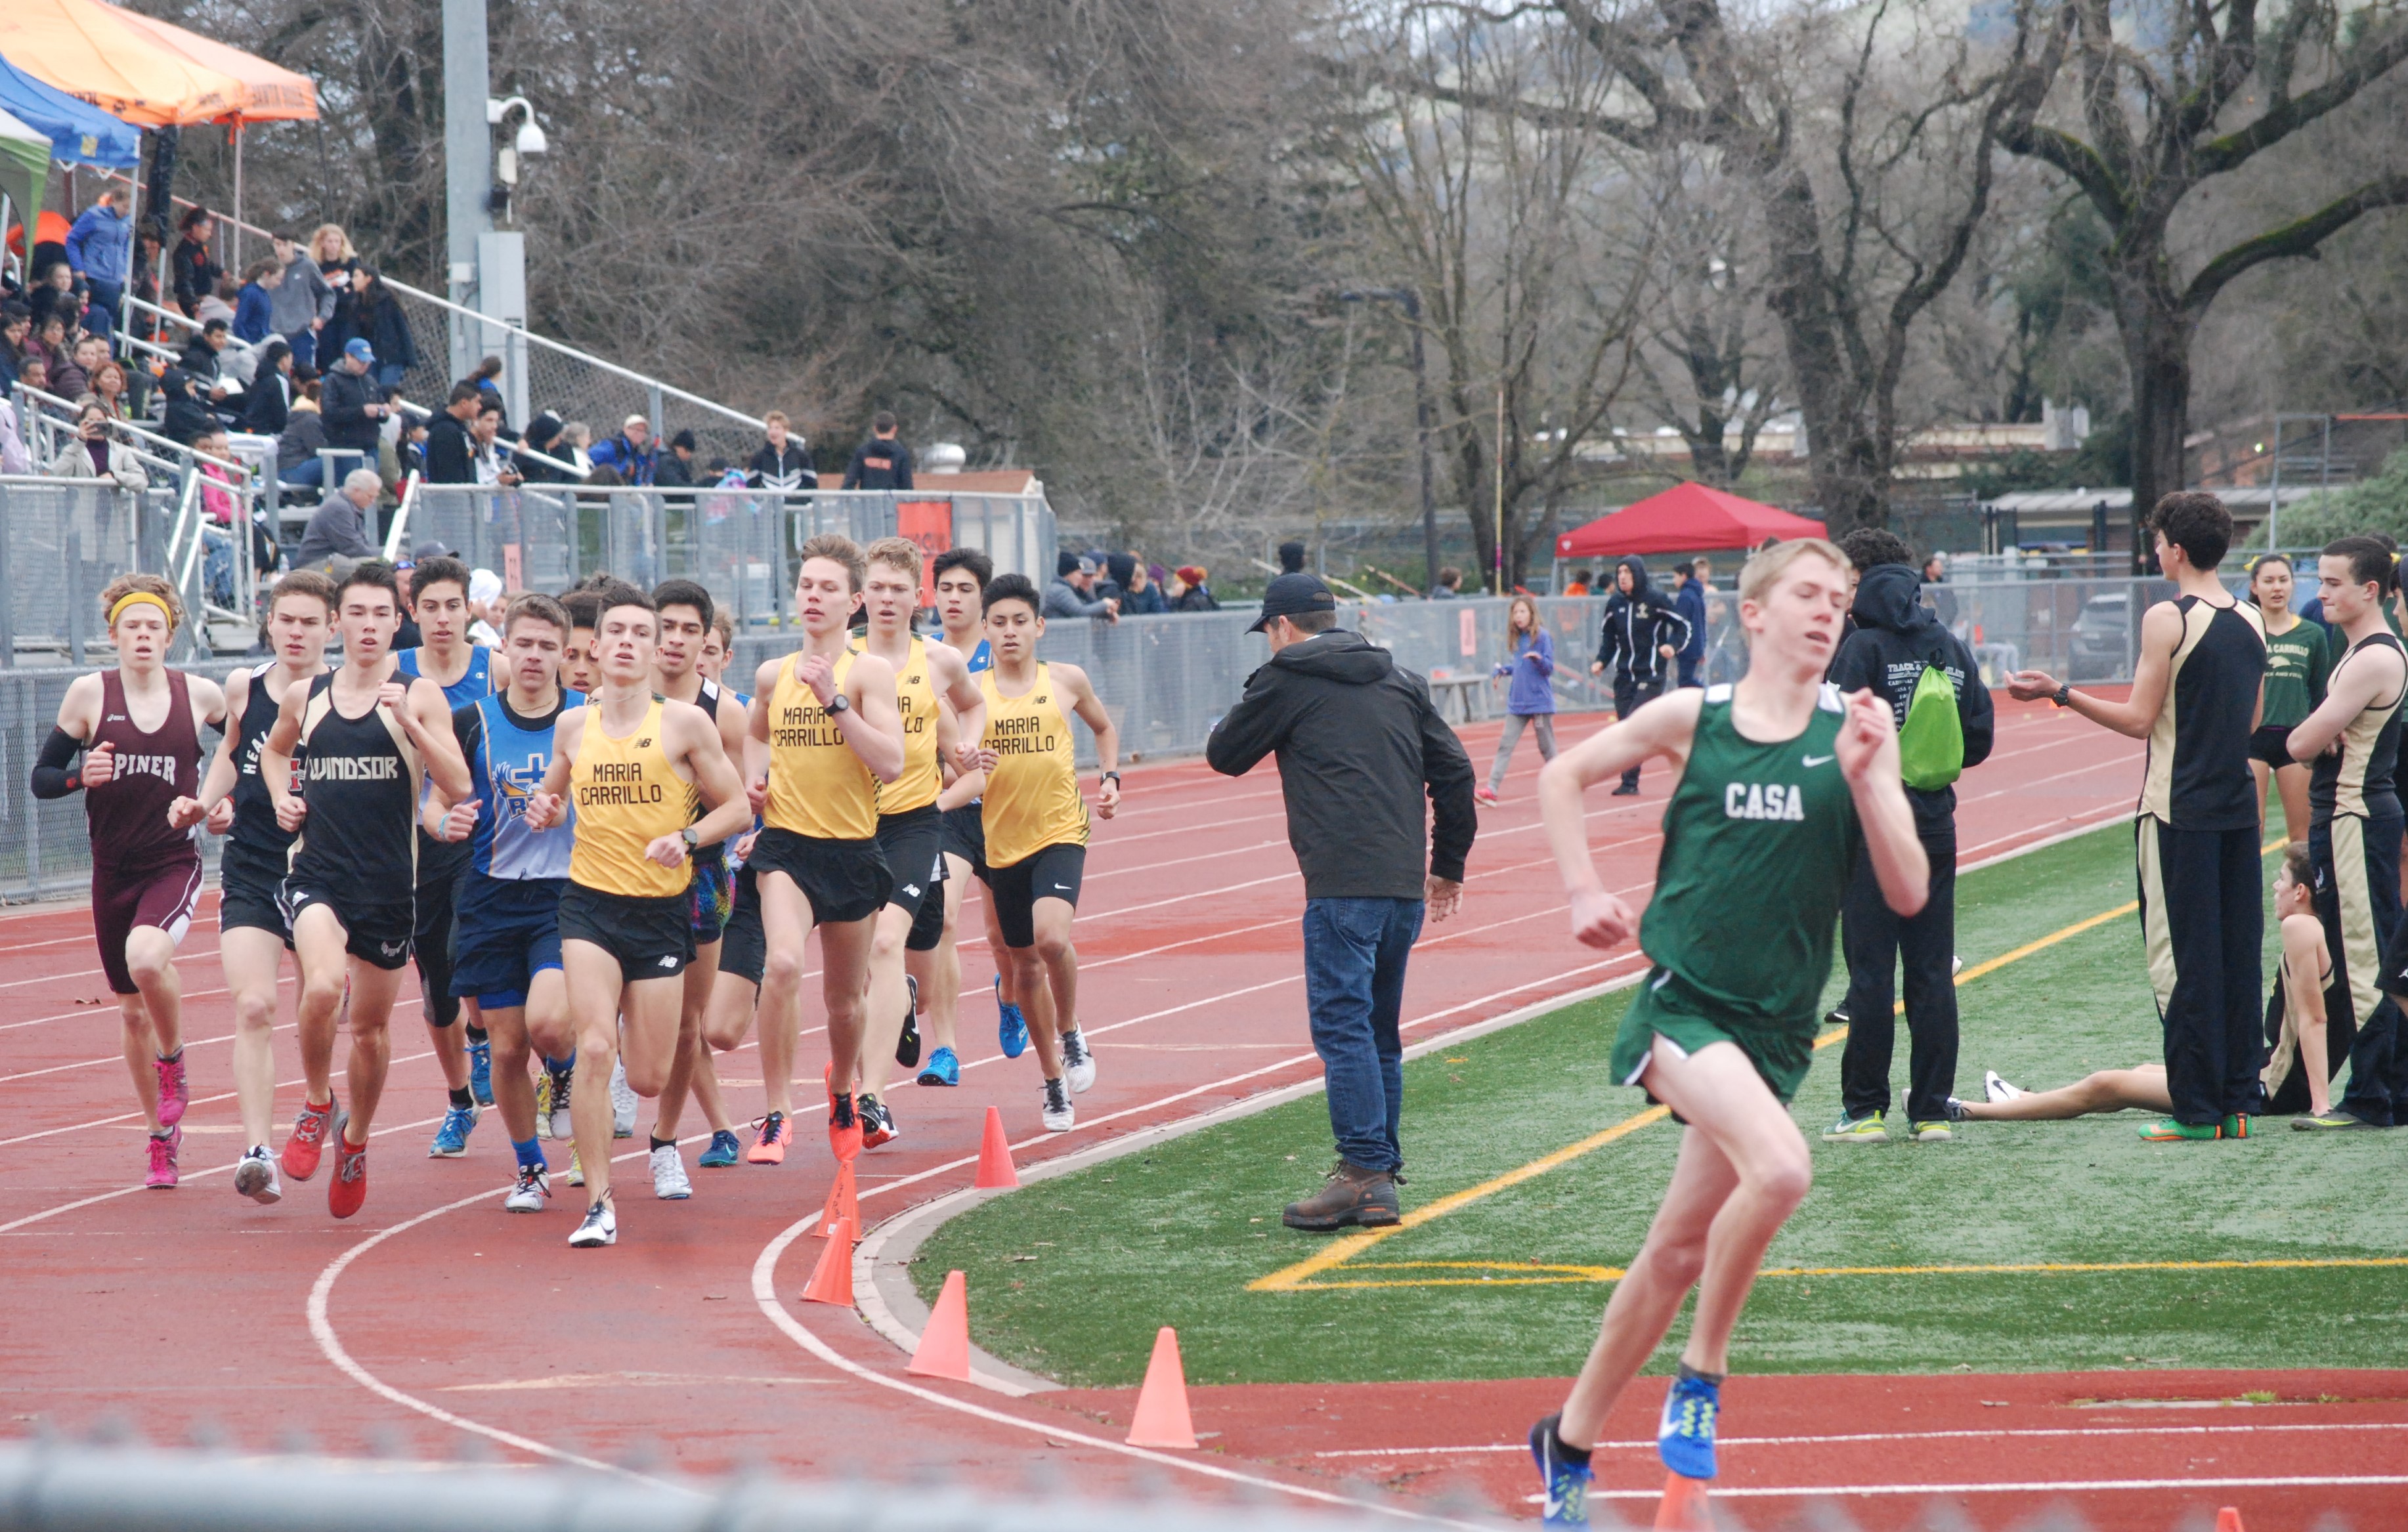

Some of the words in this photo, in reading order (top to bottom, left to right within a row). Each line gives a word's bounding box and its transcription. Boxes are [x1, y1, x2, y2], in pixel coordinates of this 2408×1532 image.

[2273, 644, 2309, 657] CARRILLO
[1887, 662, 1915, 672] TRACK
[783, 706, 825, 725] MARIA
[995, 716, 1039, 735] MARIA
[775, 727, 845, 747] CARRILLO
[112, 753, 176, 786] PINER
[309, 757, 398, 780] WINDSOR
[593, 762, 642, 782] MARIA
[581, 784, 662, 806] CARRILLO
[1725, 782, 1805, 821] CASA
